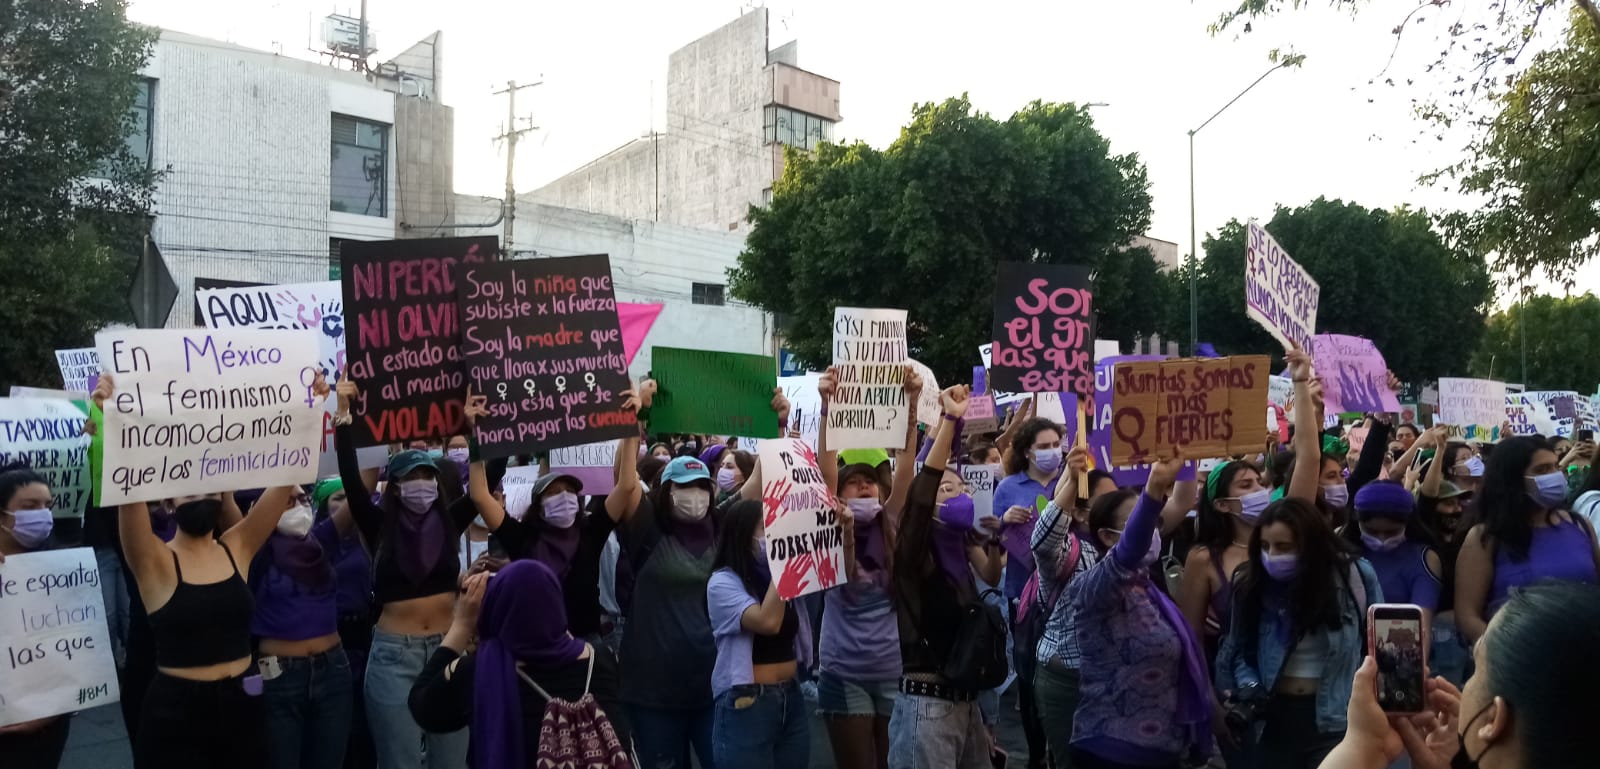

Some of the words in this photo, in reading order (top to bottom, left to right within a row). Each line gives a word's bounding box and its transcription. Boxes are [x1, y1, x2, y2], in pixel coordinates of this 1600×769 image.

[353, 262, 383, 301] NI
[1250, 223, 1265, 255] SE
[1267, 238, 1279, 267] LO
[1279, 253, 1317, 310] DEBEMOS
[466, 270, 504, 302] Soy
[511, 269, 527, 297] la
[534, 274, 577, 295] niña
[580, 275, 612, 300] que
[1246, 274, 1278, 322] NUNCA
[1258, 256, 1268, 281] A
[1271, 266, 1290, 306] LAS
[1292, 291, 1310, 328] QUE
[208, 291, 279, 329] AQUI
[465, 297, 532, 322] subiste
[537, 302, 548, 316] x
[552, 295, 566, 315] la
[568, 293, 616, 315] fuerza
[358, 308, 390, 350] NI
[466, 325, 504, 359] Soy
[506, 325, 522, 351] la
[525, 322, 584, 349] madre
[590, 328, 619, 351] que
[1003, 317, 1045, 349] el
[1051, 316, 1091, 349] gr
[90, 351, 100, 364] PO
[112, 340, 151, 374] En
[183, 334, 282, 375] México
[351, 351, 376, 379] al
[382, 339, 444, 372] estado
[855, 340, 870, 361] TU
[991, 340, 1037, 369] las
[471, 364, 501, 393] que
[504, 357, 537, 381] llora
[538, 358, 548, 375] x
[550, 358, 574, 376] sus
[575, 349, 627, 375] muertas
[860, 364, 906, 386] HERMAN
[1116, 366, 1186, 397] Juntas
[1190, 363, 1256, 393] Somos
[116, 382, 144, 416] el
[162, 380, 291, 416] feminismo
[356, 389, 368, 417] y
[381, 375, 401, 401] al
[407, 369, 463, 396] macho
[489, 401, 518, 422] soy
[559, 391, 588, 417] que
[592, 384, 612, 405] te
[864, 386, 905, 407] ABUELA
[121, 413, 244, 449] incomoda
[251, 410, 292, 438] más
[364, 398, 466, 443] VIOLAD
[518, 418, 562, 443] pagar
[566, 414, 586, 432] las
[1155, 407, 1234, 446] FUERTES
[1507, 414, 1528, 425] TU
[1509, 424, 1538, 434] ULPA
[112, 466, 156, 495] que
[161, 455, 192, 482] los
[200, 443, 311, 479] feminicidios
[550, 446, 570, 466] NO
[779, 451, 793, 470] YO
[815, 507, 836, 527] NO
[26, 561, 99, 596] espantas
[21, 603, 96, 632] luchan
[9, 643, 46, 670] las
[55, 637, 95, 661] que
[77, 683, 109, 704] #8M
